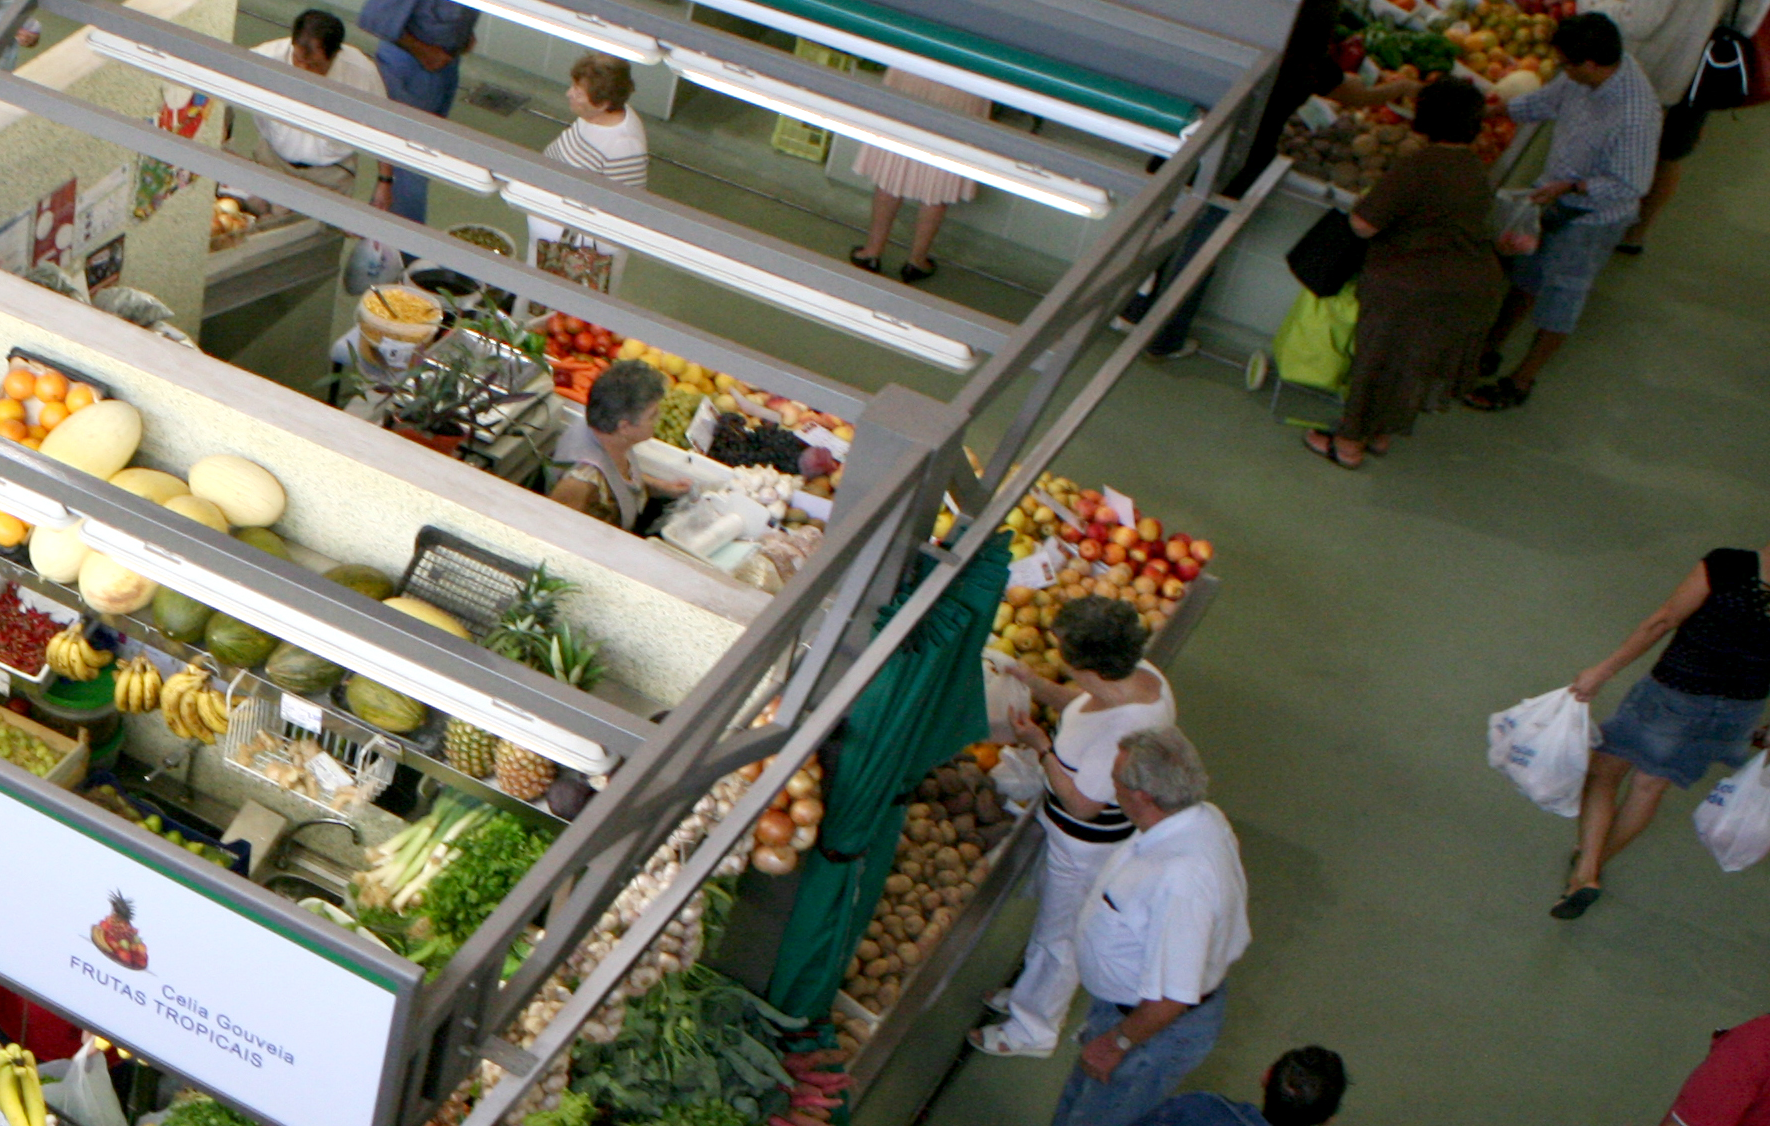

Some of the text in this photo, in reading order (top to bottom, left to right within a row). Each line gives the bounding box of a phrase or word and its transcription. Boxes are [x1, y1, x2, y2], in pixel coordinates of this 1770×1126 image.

[70, 955, 263, 1069] FRUTAS TROPICAIS
[161, 984, 295, 1066] Celia Gouveia
